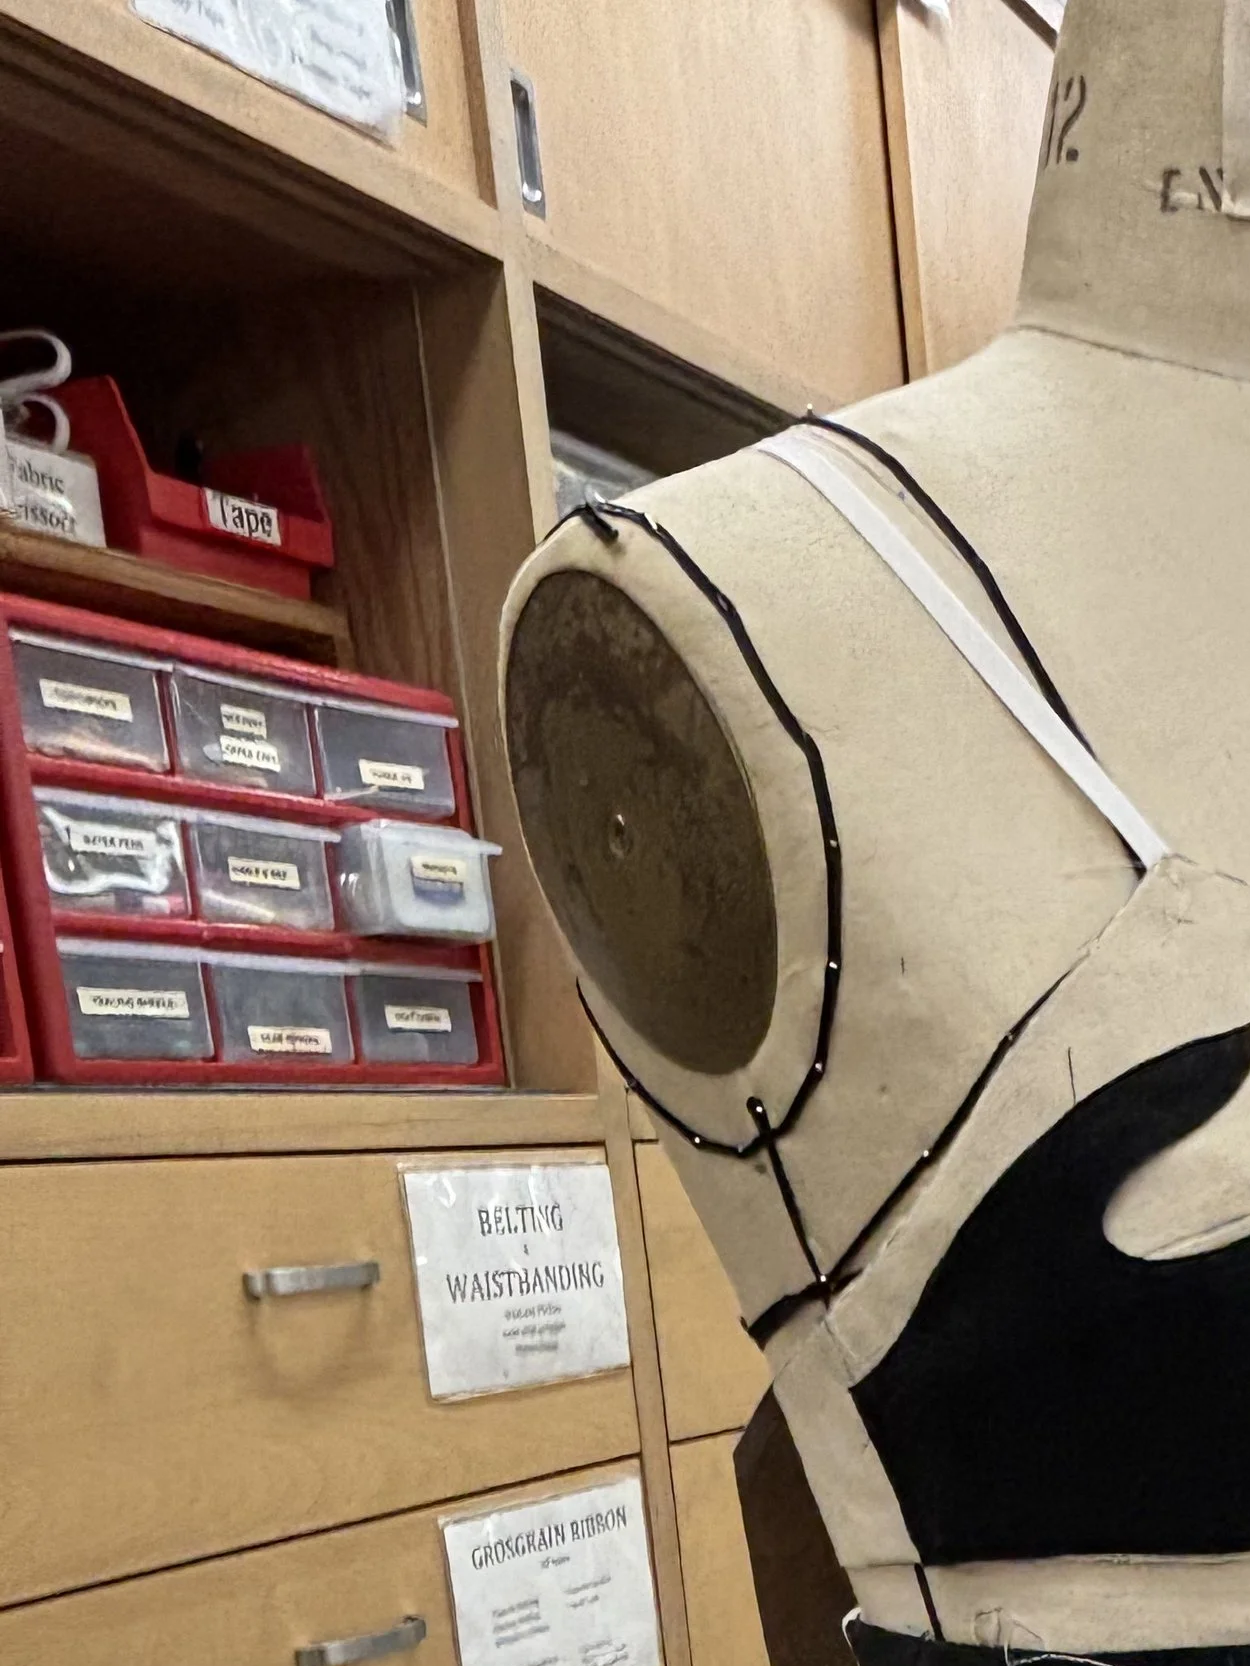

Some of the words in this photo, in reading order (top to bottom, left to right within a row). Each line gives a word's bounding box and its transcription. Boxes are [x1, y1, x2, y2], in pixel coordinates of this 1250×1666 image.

[211, 489, 273, 538] Tape
[477, 1202, 564, 1237] BELTING
[446, 1260, 605, 1304] WAISTBANDING
[471, 1523, 566, 1570] GROSGRAIN
[571, 1504, 628, 1543] RIBBON
